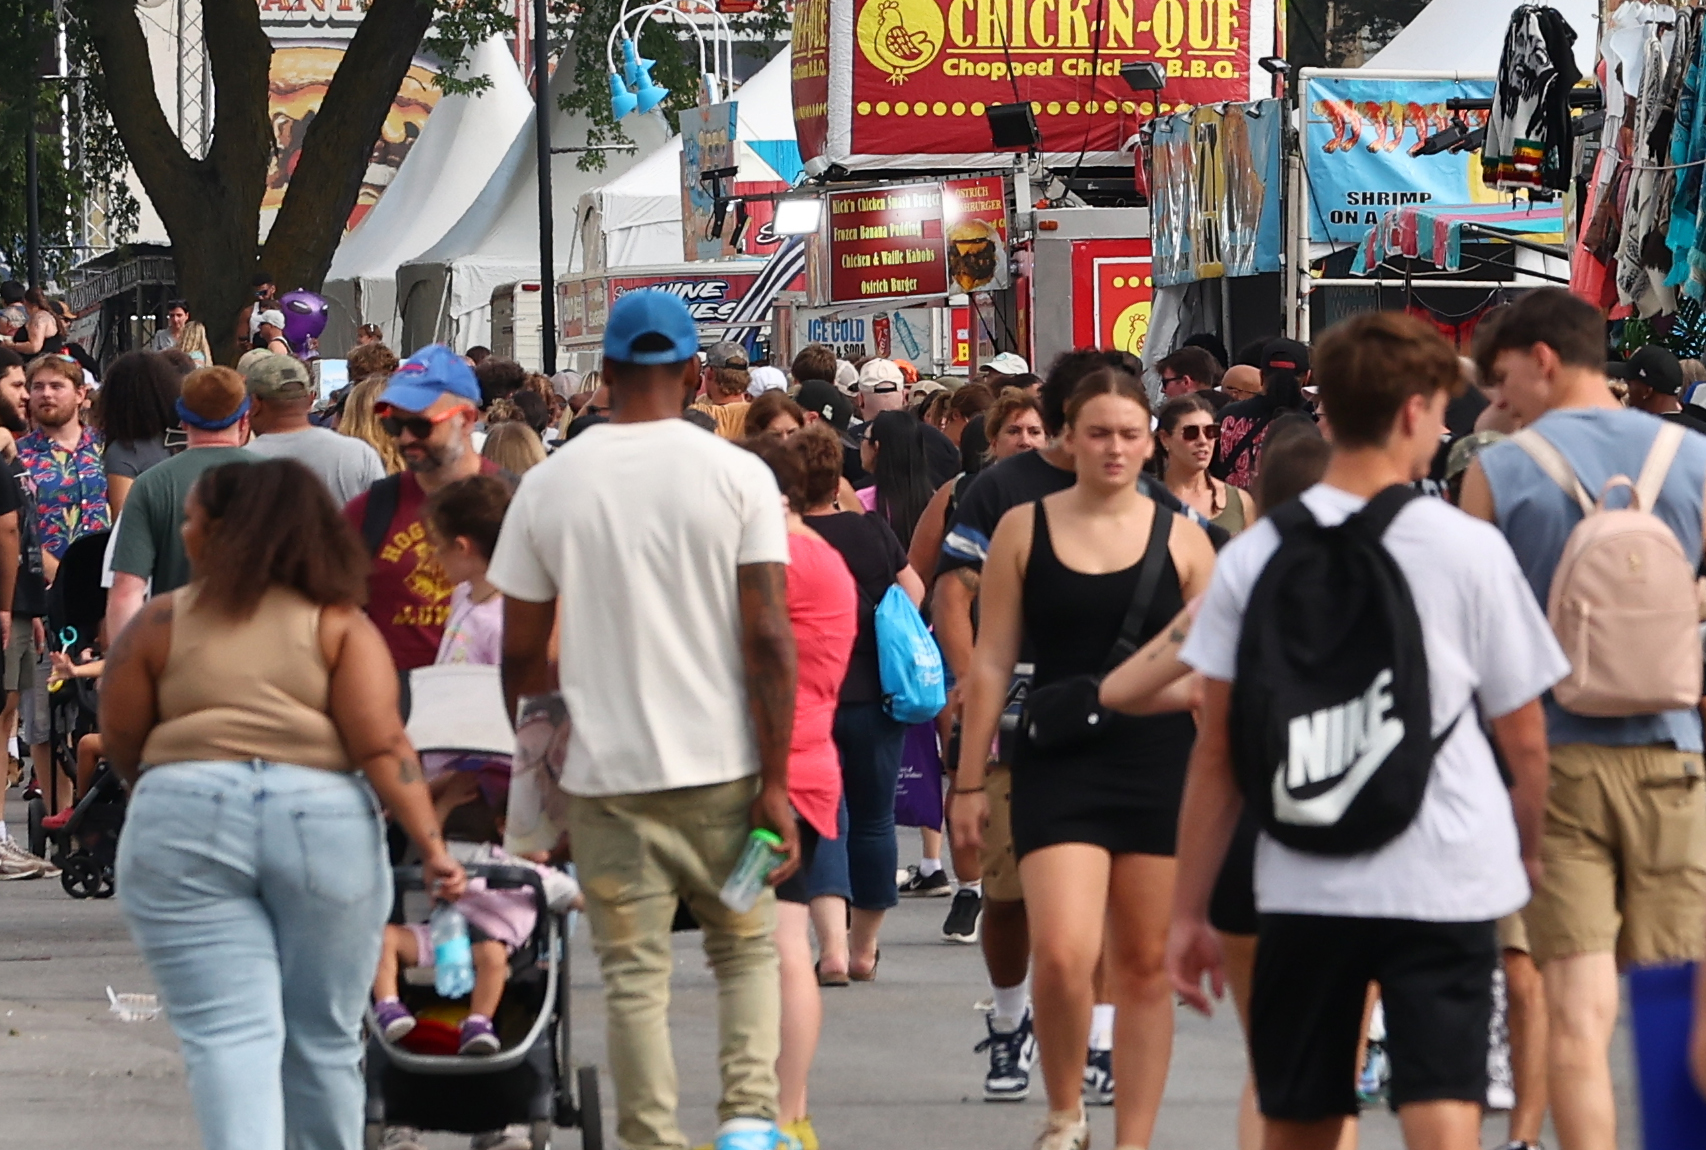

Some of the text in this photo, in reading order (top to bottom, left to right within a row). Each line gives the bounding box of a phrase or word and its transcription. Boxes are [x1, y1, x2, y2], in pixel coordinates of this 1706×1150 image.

[942, 57, 1240, 81] Chopped Chic B.B.Q.
[858, 196, 886, 212] Chicken
[887, 194, 911, 210] Smash
[912, 192, 940, 209] Burger
[955, 186, 989, 198] OSTRICH
[1346, 191, 1433, 207] SHRIMP
[1330, 210, 1359, 225] ON
[1364, 211, 1378, 225] A
[833, 220, 922, 242] Frozen Banana Pudding
[841, 248, 935, 269] Chicken & Waffle Kabobs
[860, 276, 918, 295] Ostrich Burger
[807, 318, 865, 343] ICE COLD
[1286, 668, 1402, 790] NIKE
